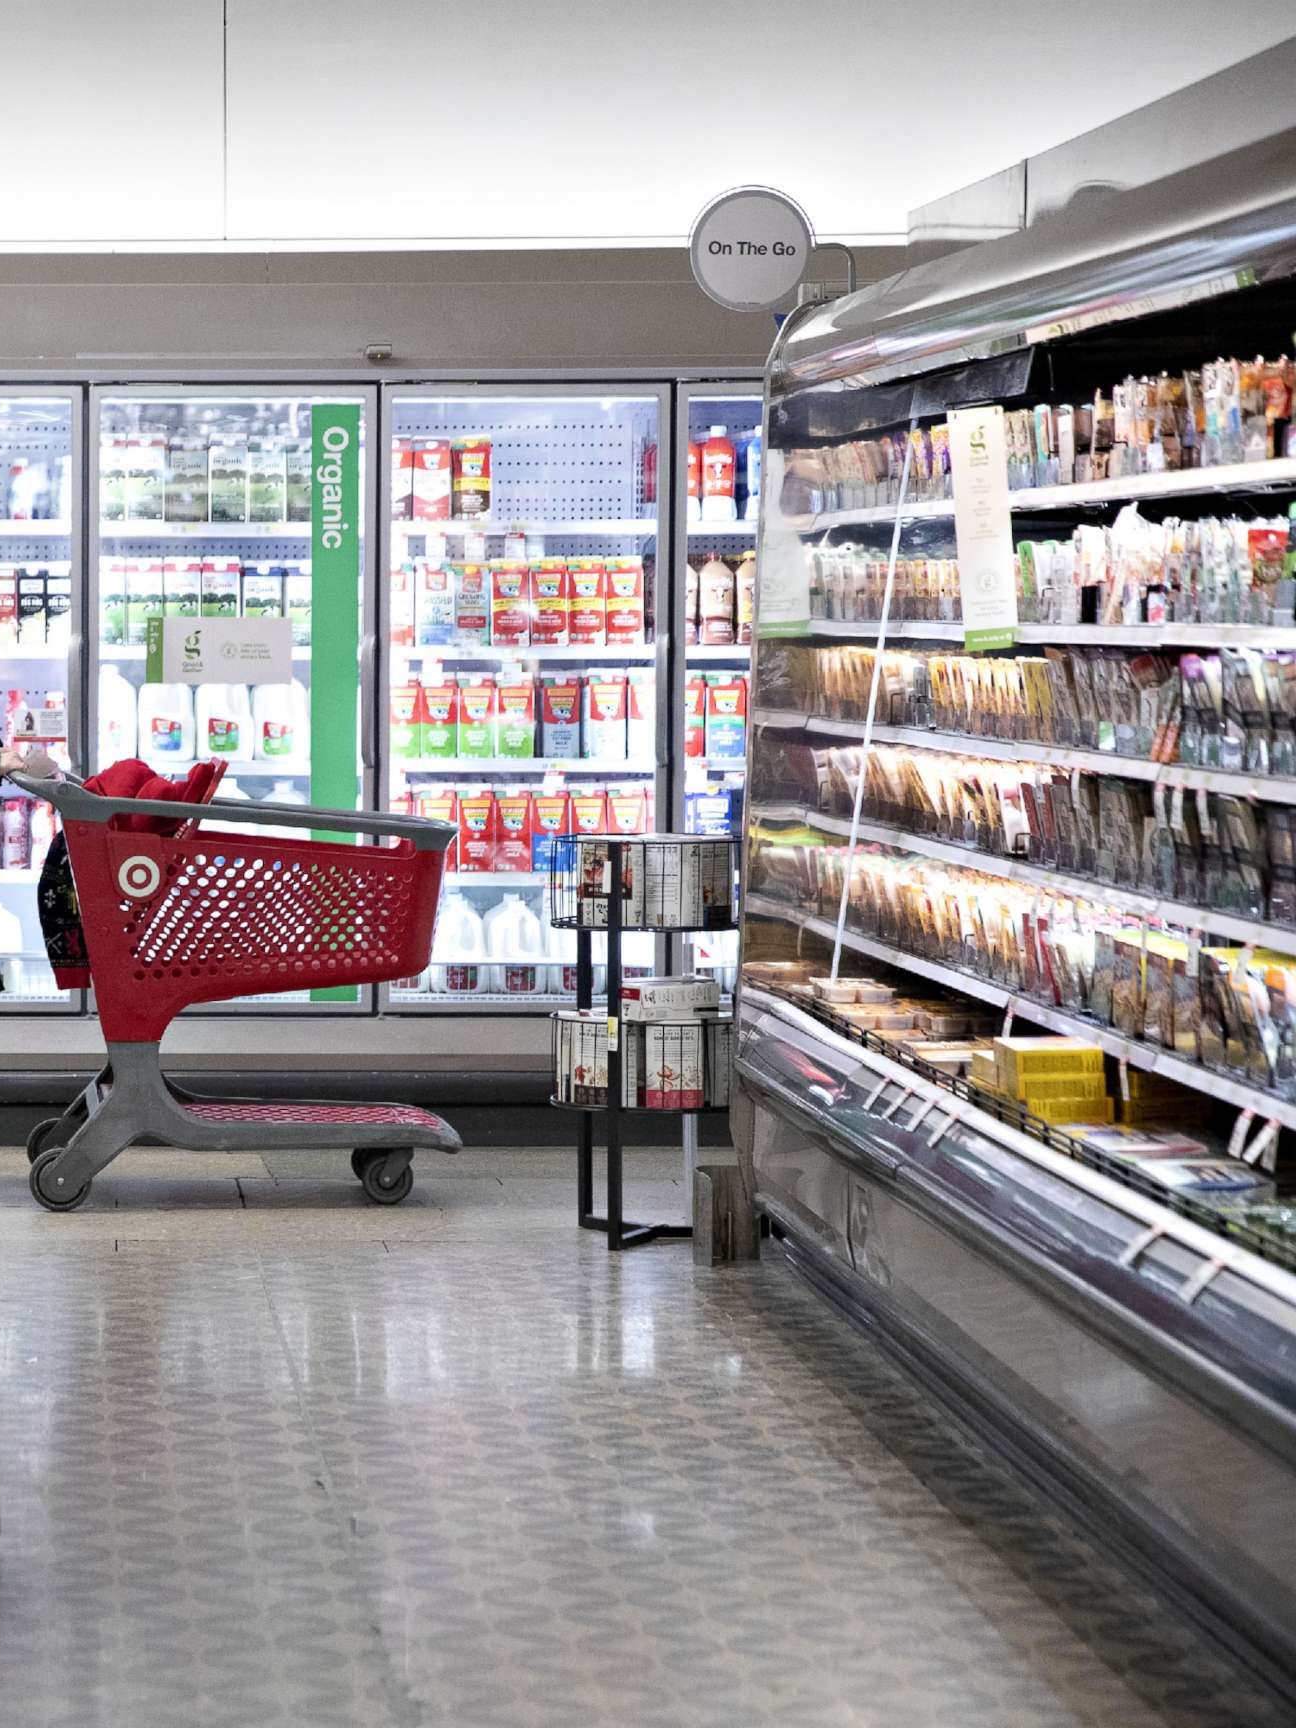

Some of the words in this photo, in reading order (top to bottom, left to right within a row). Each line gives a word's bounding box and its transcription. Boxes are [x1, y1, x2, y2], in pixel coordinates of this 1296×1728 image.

[708, 240, 732, 256] On
[736, 240, 768, 256] The
[772, 241, 796, 257] Go
[316, 426, 349, 549] Organic
